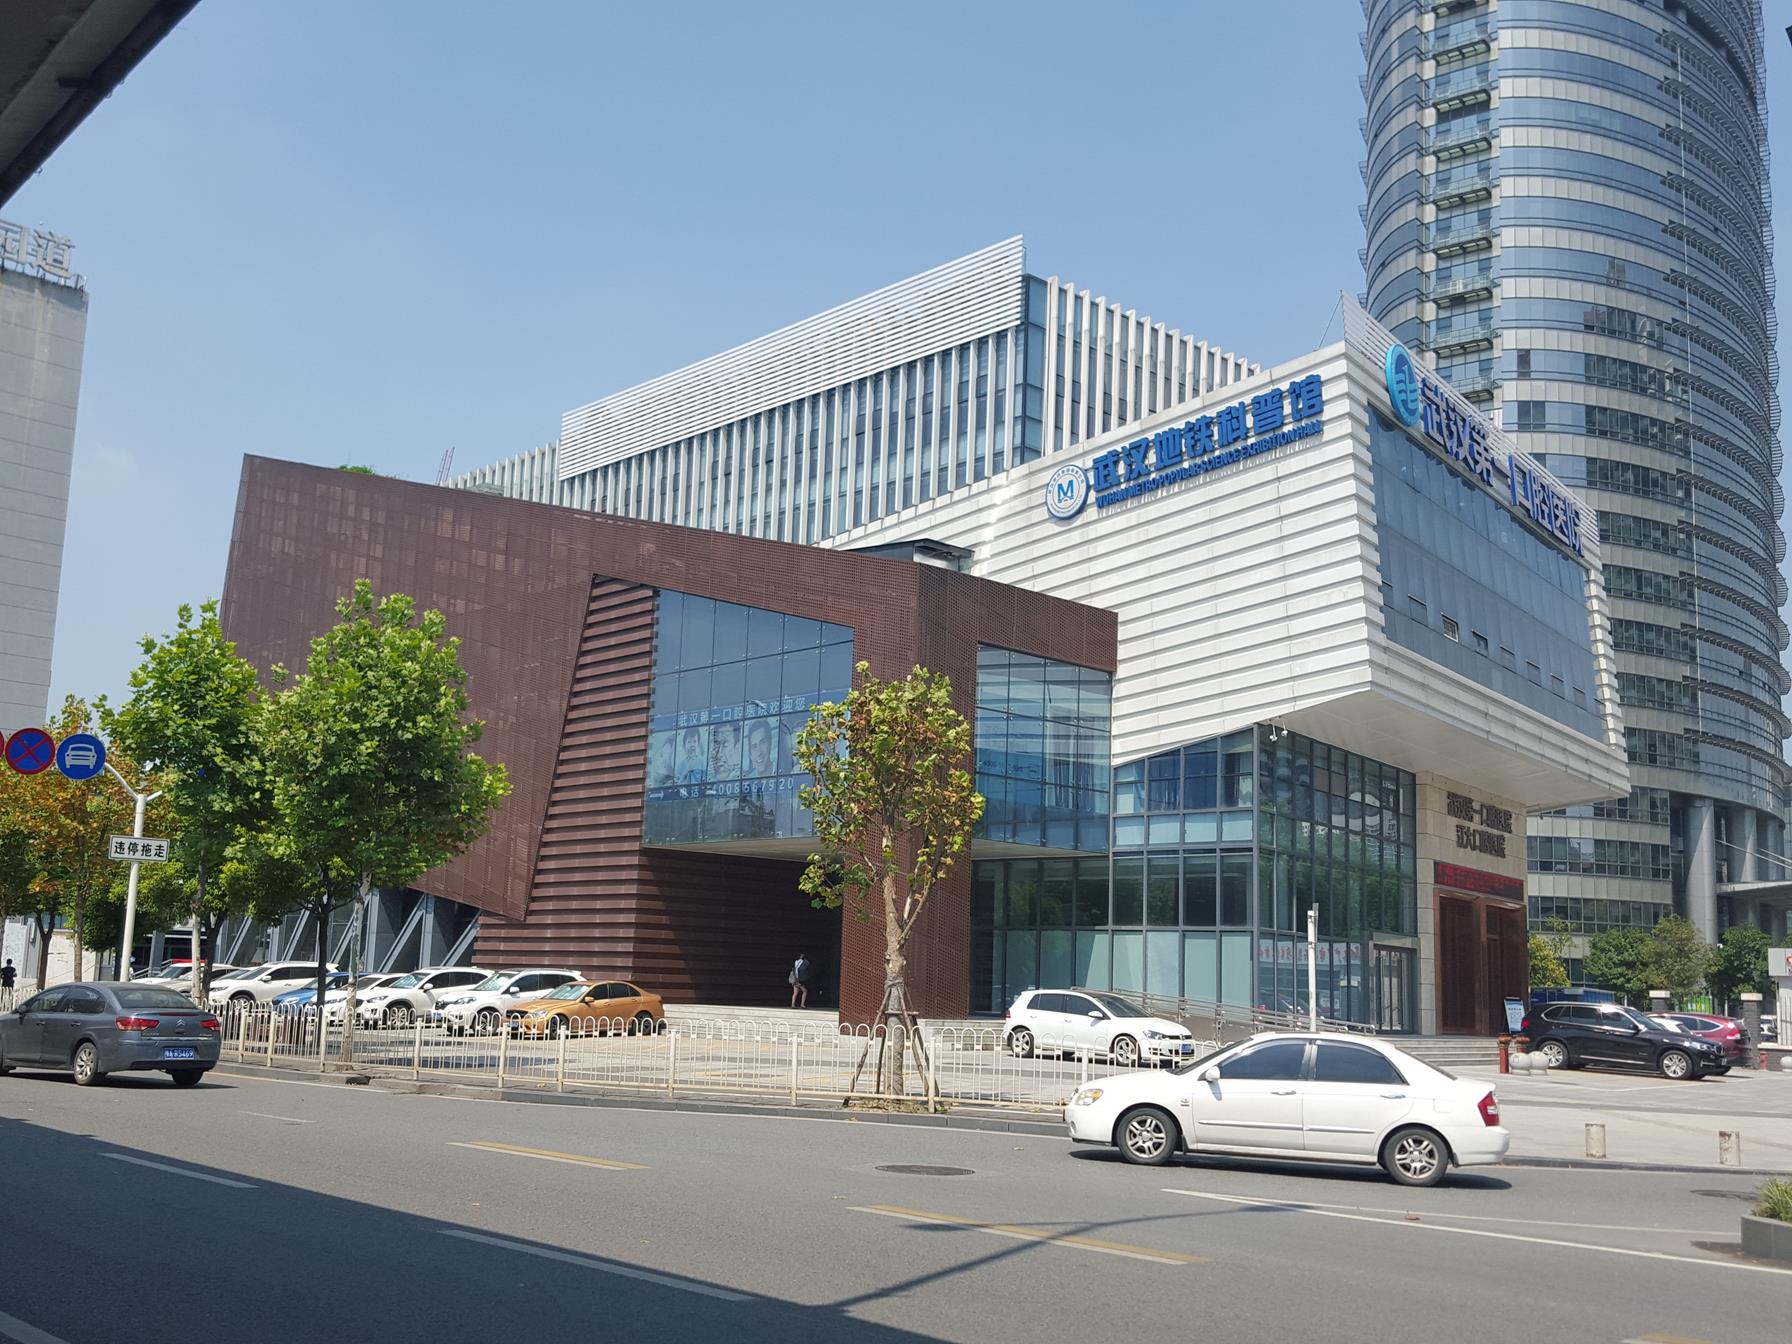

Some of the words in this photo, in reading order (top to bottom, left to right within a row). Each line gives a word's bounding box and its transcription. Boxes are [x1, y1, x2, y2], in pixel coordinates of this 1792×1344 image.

[1093, 374, 1324, 492] 武汉地铁科普馆
[1096, 486, 1127, 508] WUHAN
[1128, 478, 1158, 498] METRO
[1159, 462, 1200, 488] POPULAR
[1201, 446, 1240, 473] SCIENCE
[1241, 427, 1297, 459] EXHIBITION
[1297, 419, 1322, 439] HALL
[1421, 377, 1585, 557] 武汉第一口腔医院
[114, 841, 165, 858] 违停拖走
